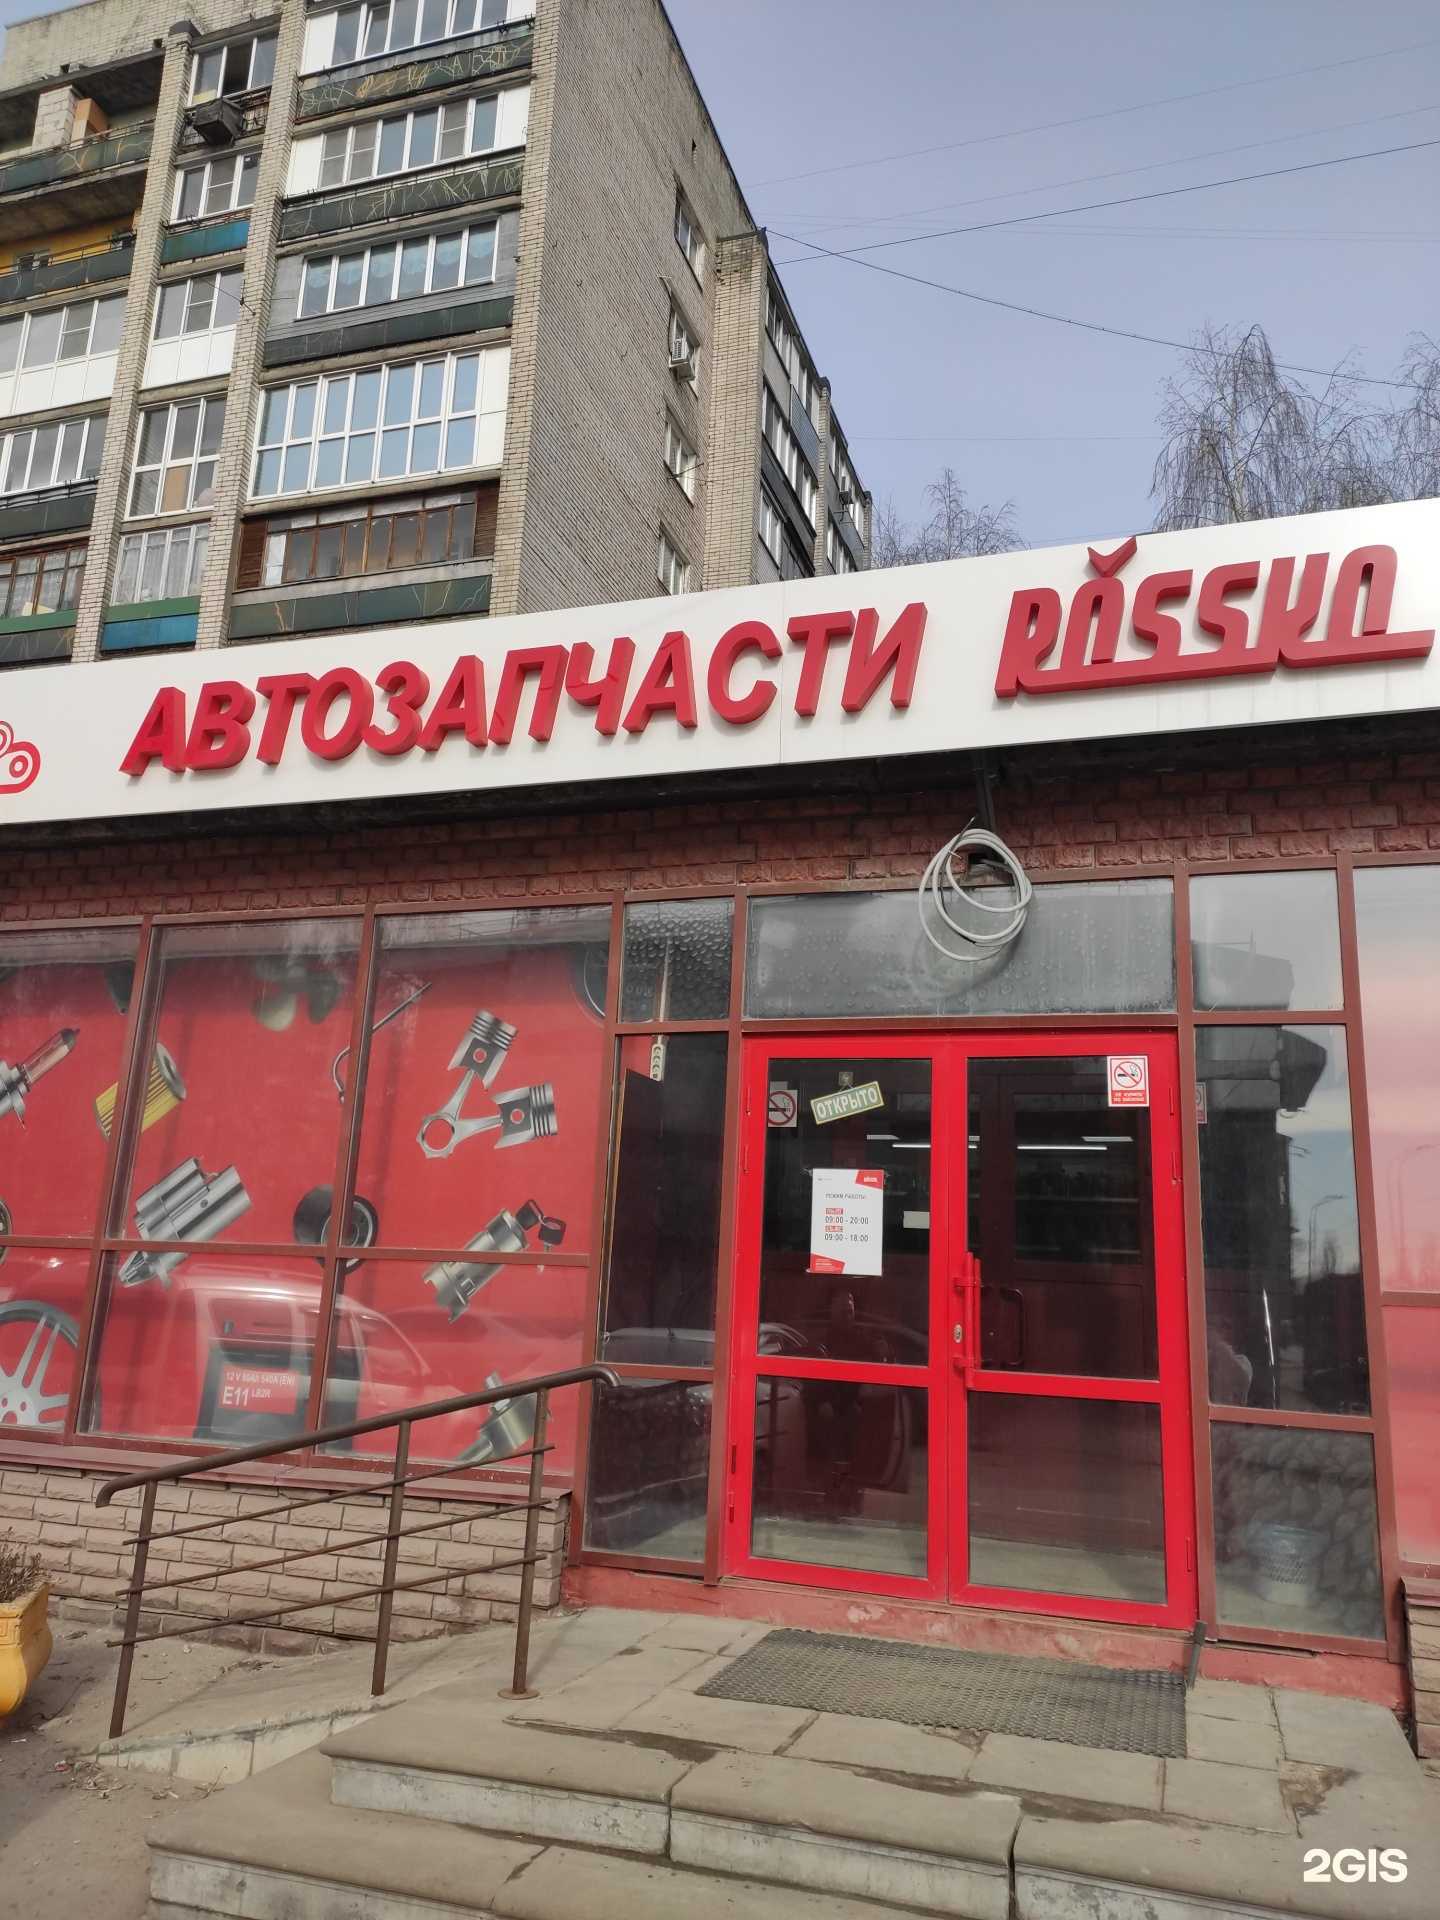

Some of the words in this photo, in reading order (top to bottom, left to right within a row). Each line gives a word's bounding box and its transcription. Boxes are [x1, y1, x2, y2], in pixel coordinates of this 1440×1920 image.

[119, 602, 928, 777] АВТОЗАПЧАСТИ
[815, 1087, 878, 1119] ОТКРЫТО
[824, 1216, 844, 1224] 09:00
[849, 1216, 869, 1225] 20:00
[824, 1233, 844, 1241] 09:00
[850, 1234, 869, 1242] 18:00
[222, 1386, 249, 1407] E11
